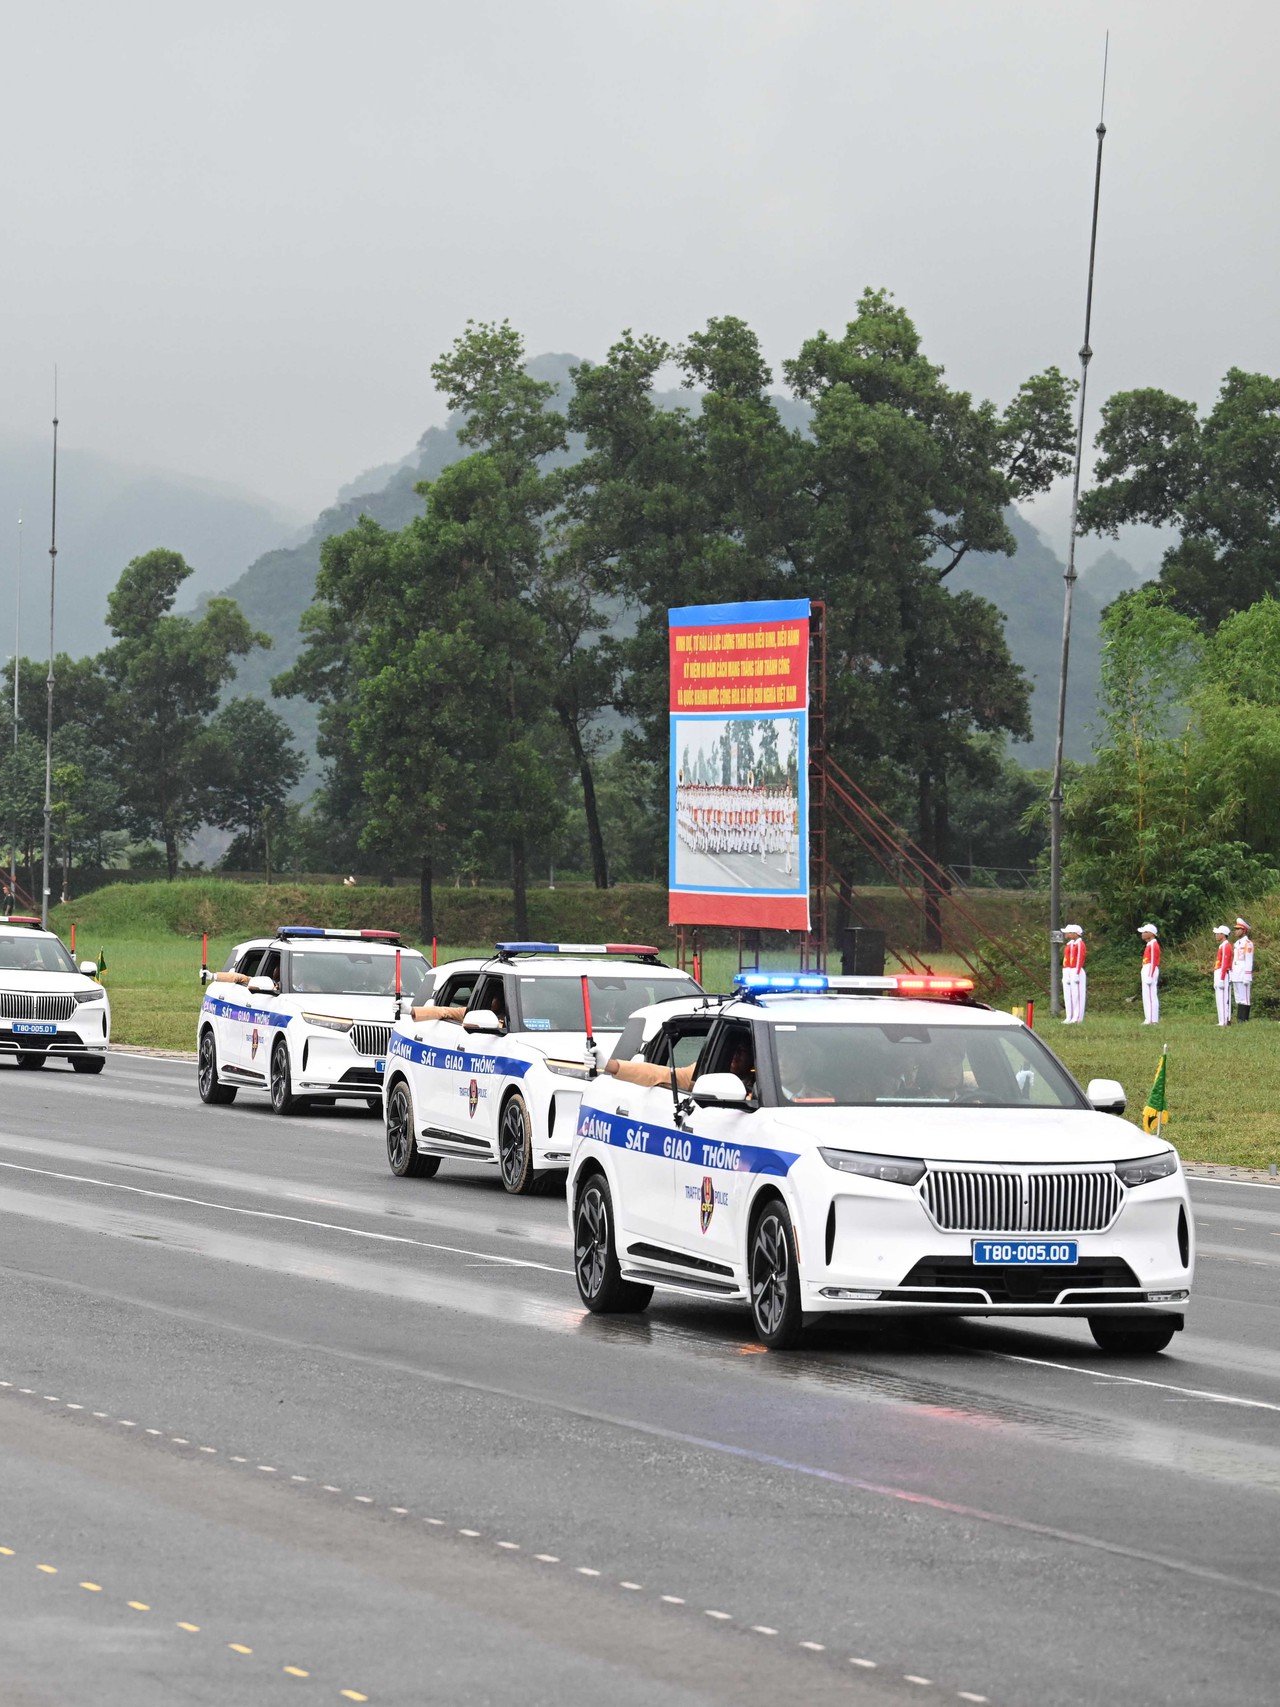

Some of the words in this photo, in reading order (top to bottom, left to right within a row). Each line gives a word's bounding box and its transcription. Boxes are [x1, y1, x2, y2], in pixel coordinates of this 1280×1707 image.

[421, 1048, 436, 1066] SÁT
[445, 1054, 463, 1070] GIAO
[471, 1056, 495, 1073] THÔNG
[625, 1125, 650, 1152] SÁT
[663, 1136, 692, 1161] GIAO
[702, 1142, 741, 1170] THÔNG
[714, 1190, 728, 1206] POLICE
[983, 1245, 1070, 1261] T80-005.00
